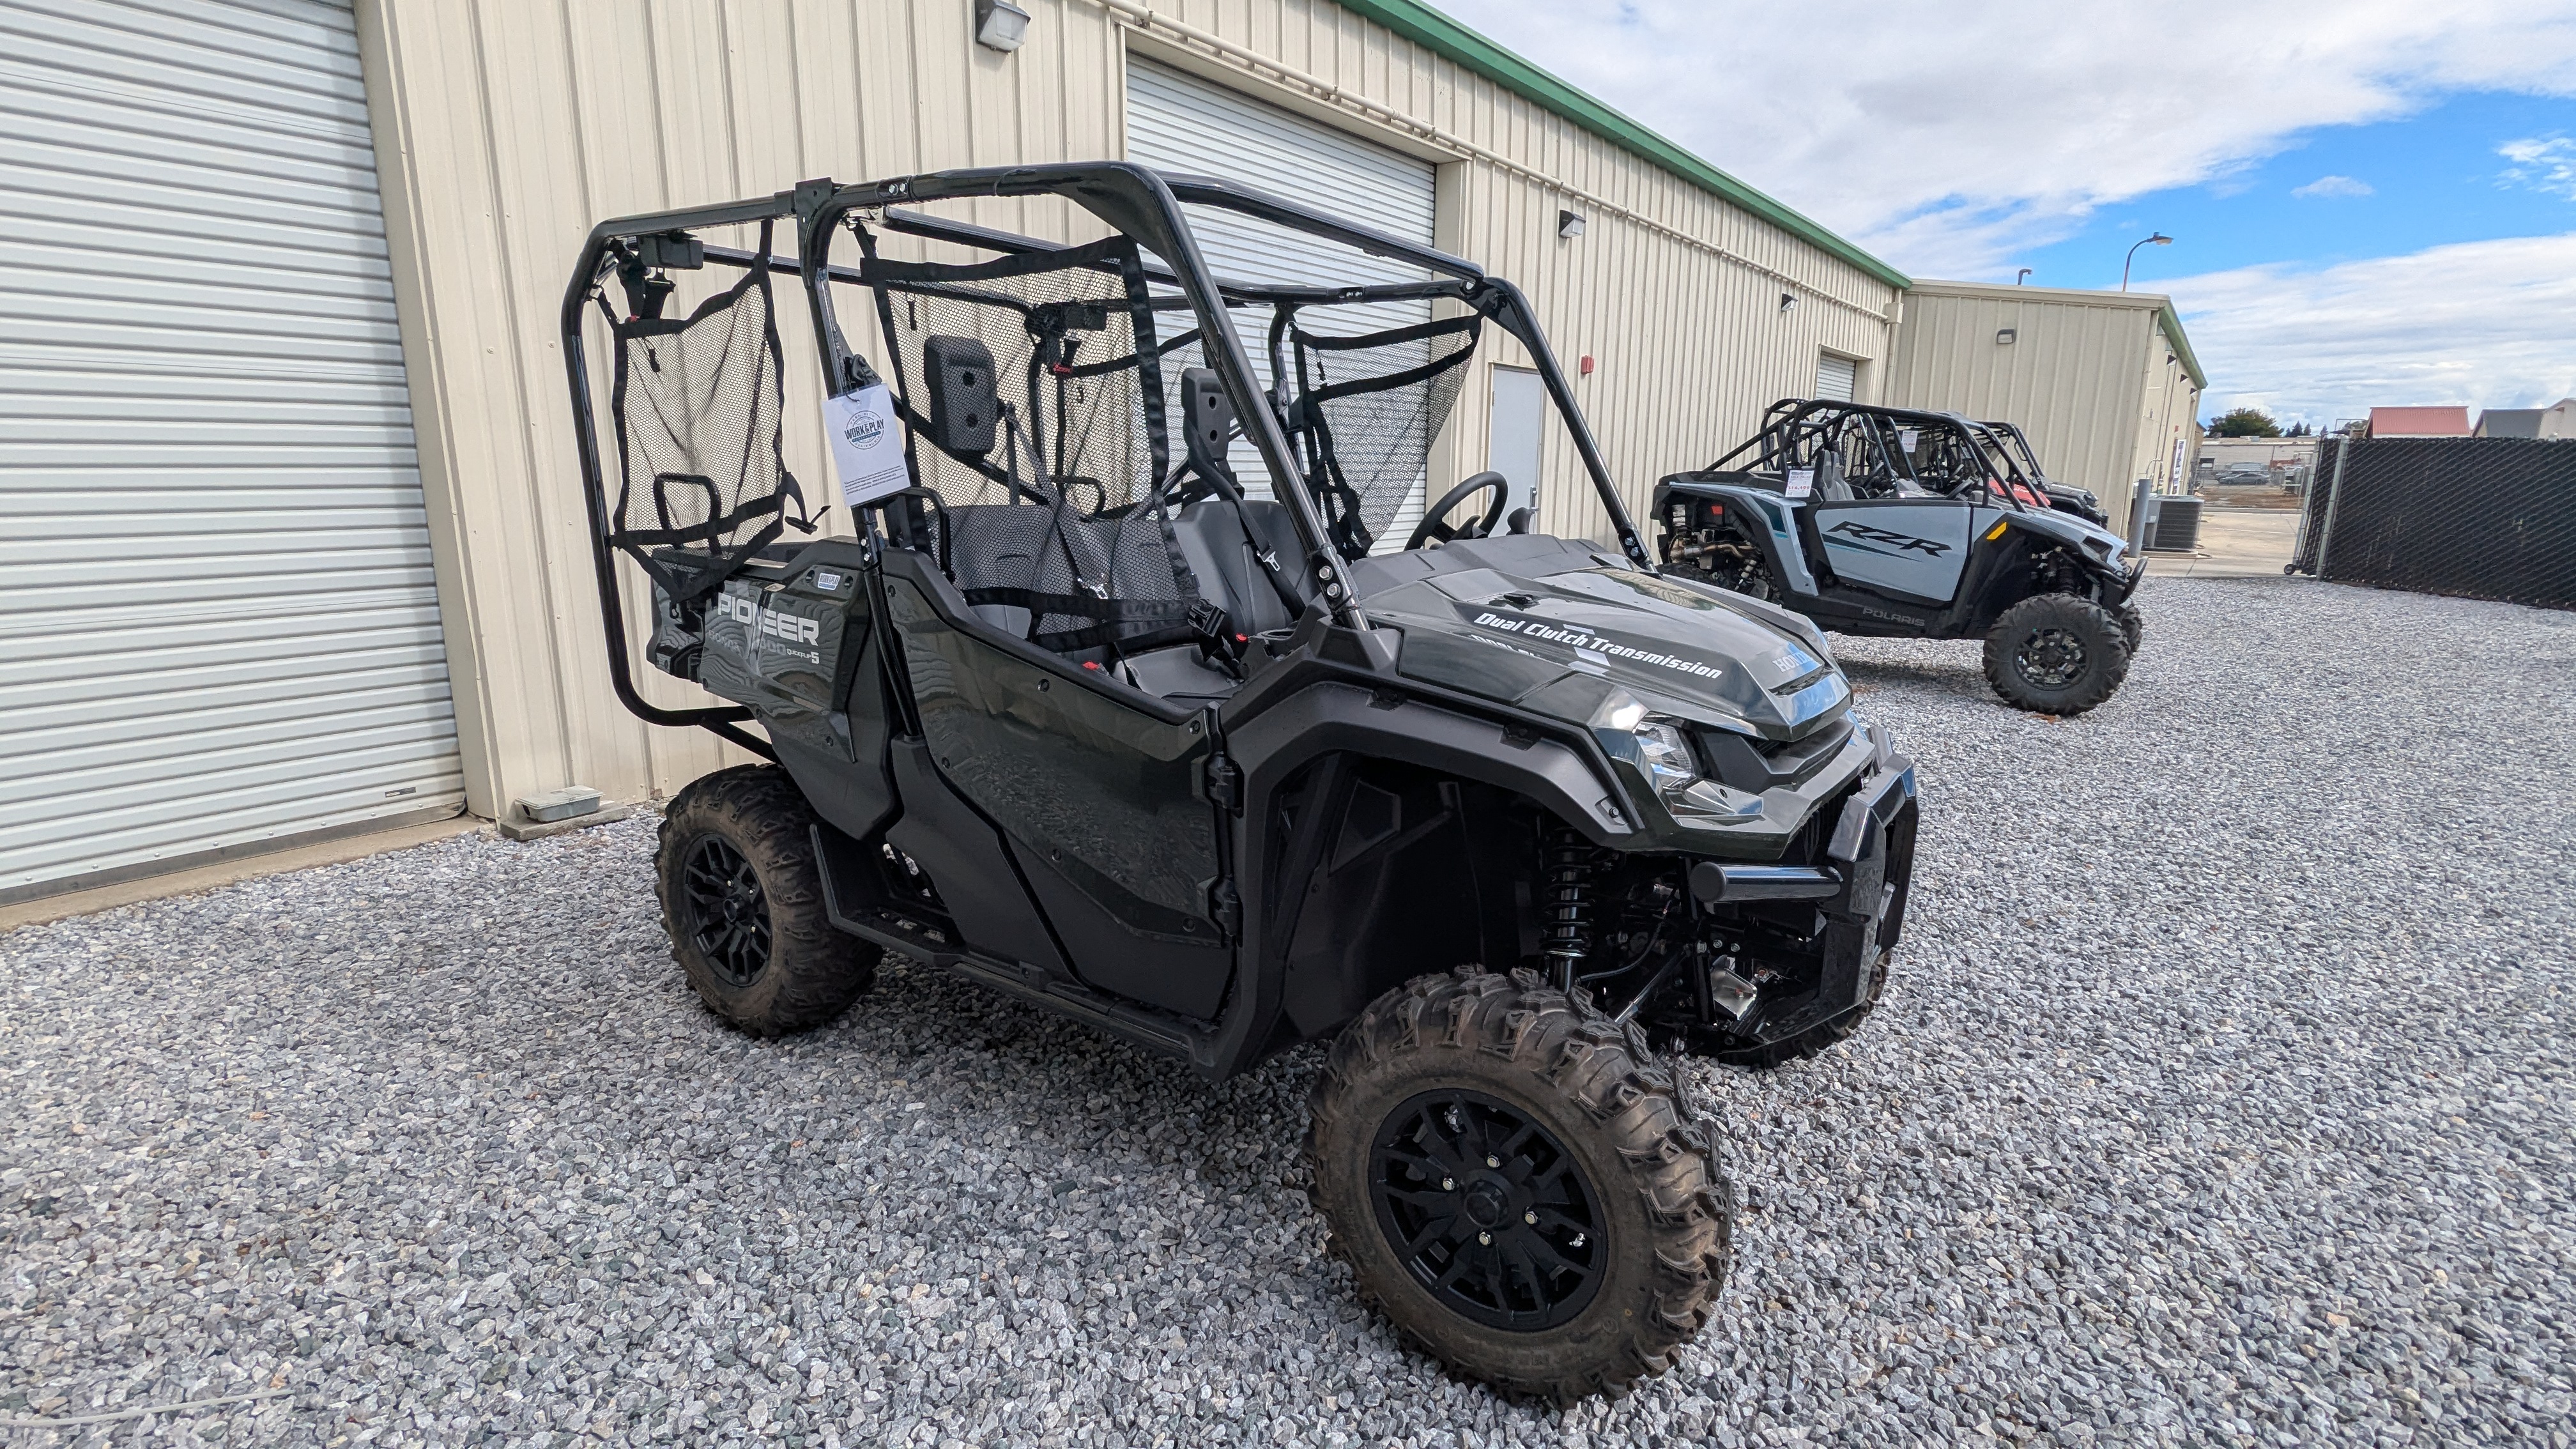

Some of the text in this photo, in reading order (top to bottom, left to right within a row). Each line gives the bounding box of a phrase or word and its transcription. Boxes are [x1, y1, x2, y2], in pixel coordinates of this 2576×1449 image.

[1825, 521, 1952, 558] RZR
[717, 592, 819, 647] PIONEER
[1862, 608, 1925, 627] POLARIS
[810, 650, 820, 664] 5
[1473, 612, 1526, 631] Dual
[1522, 624, 1590, 647] Clutch
[1589, 637, 1723, 680] Transmission
